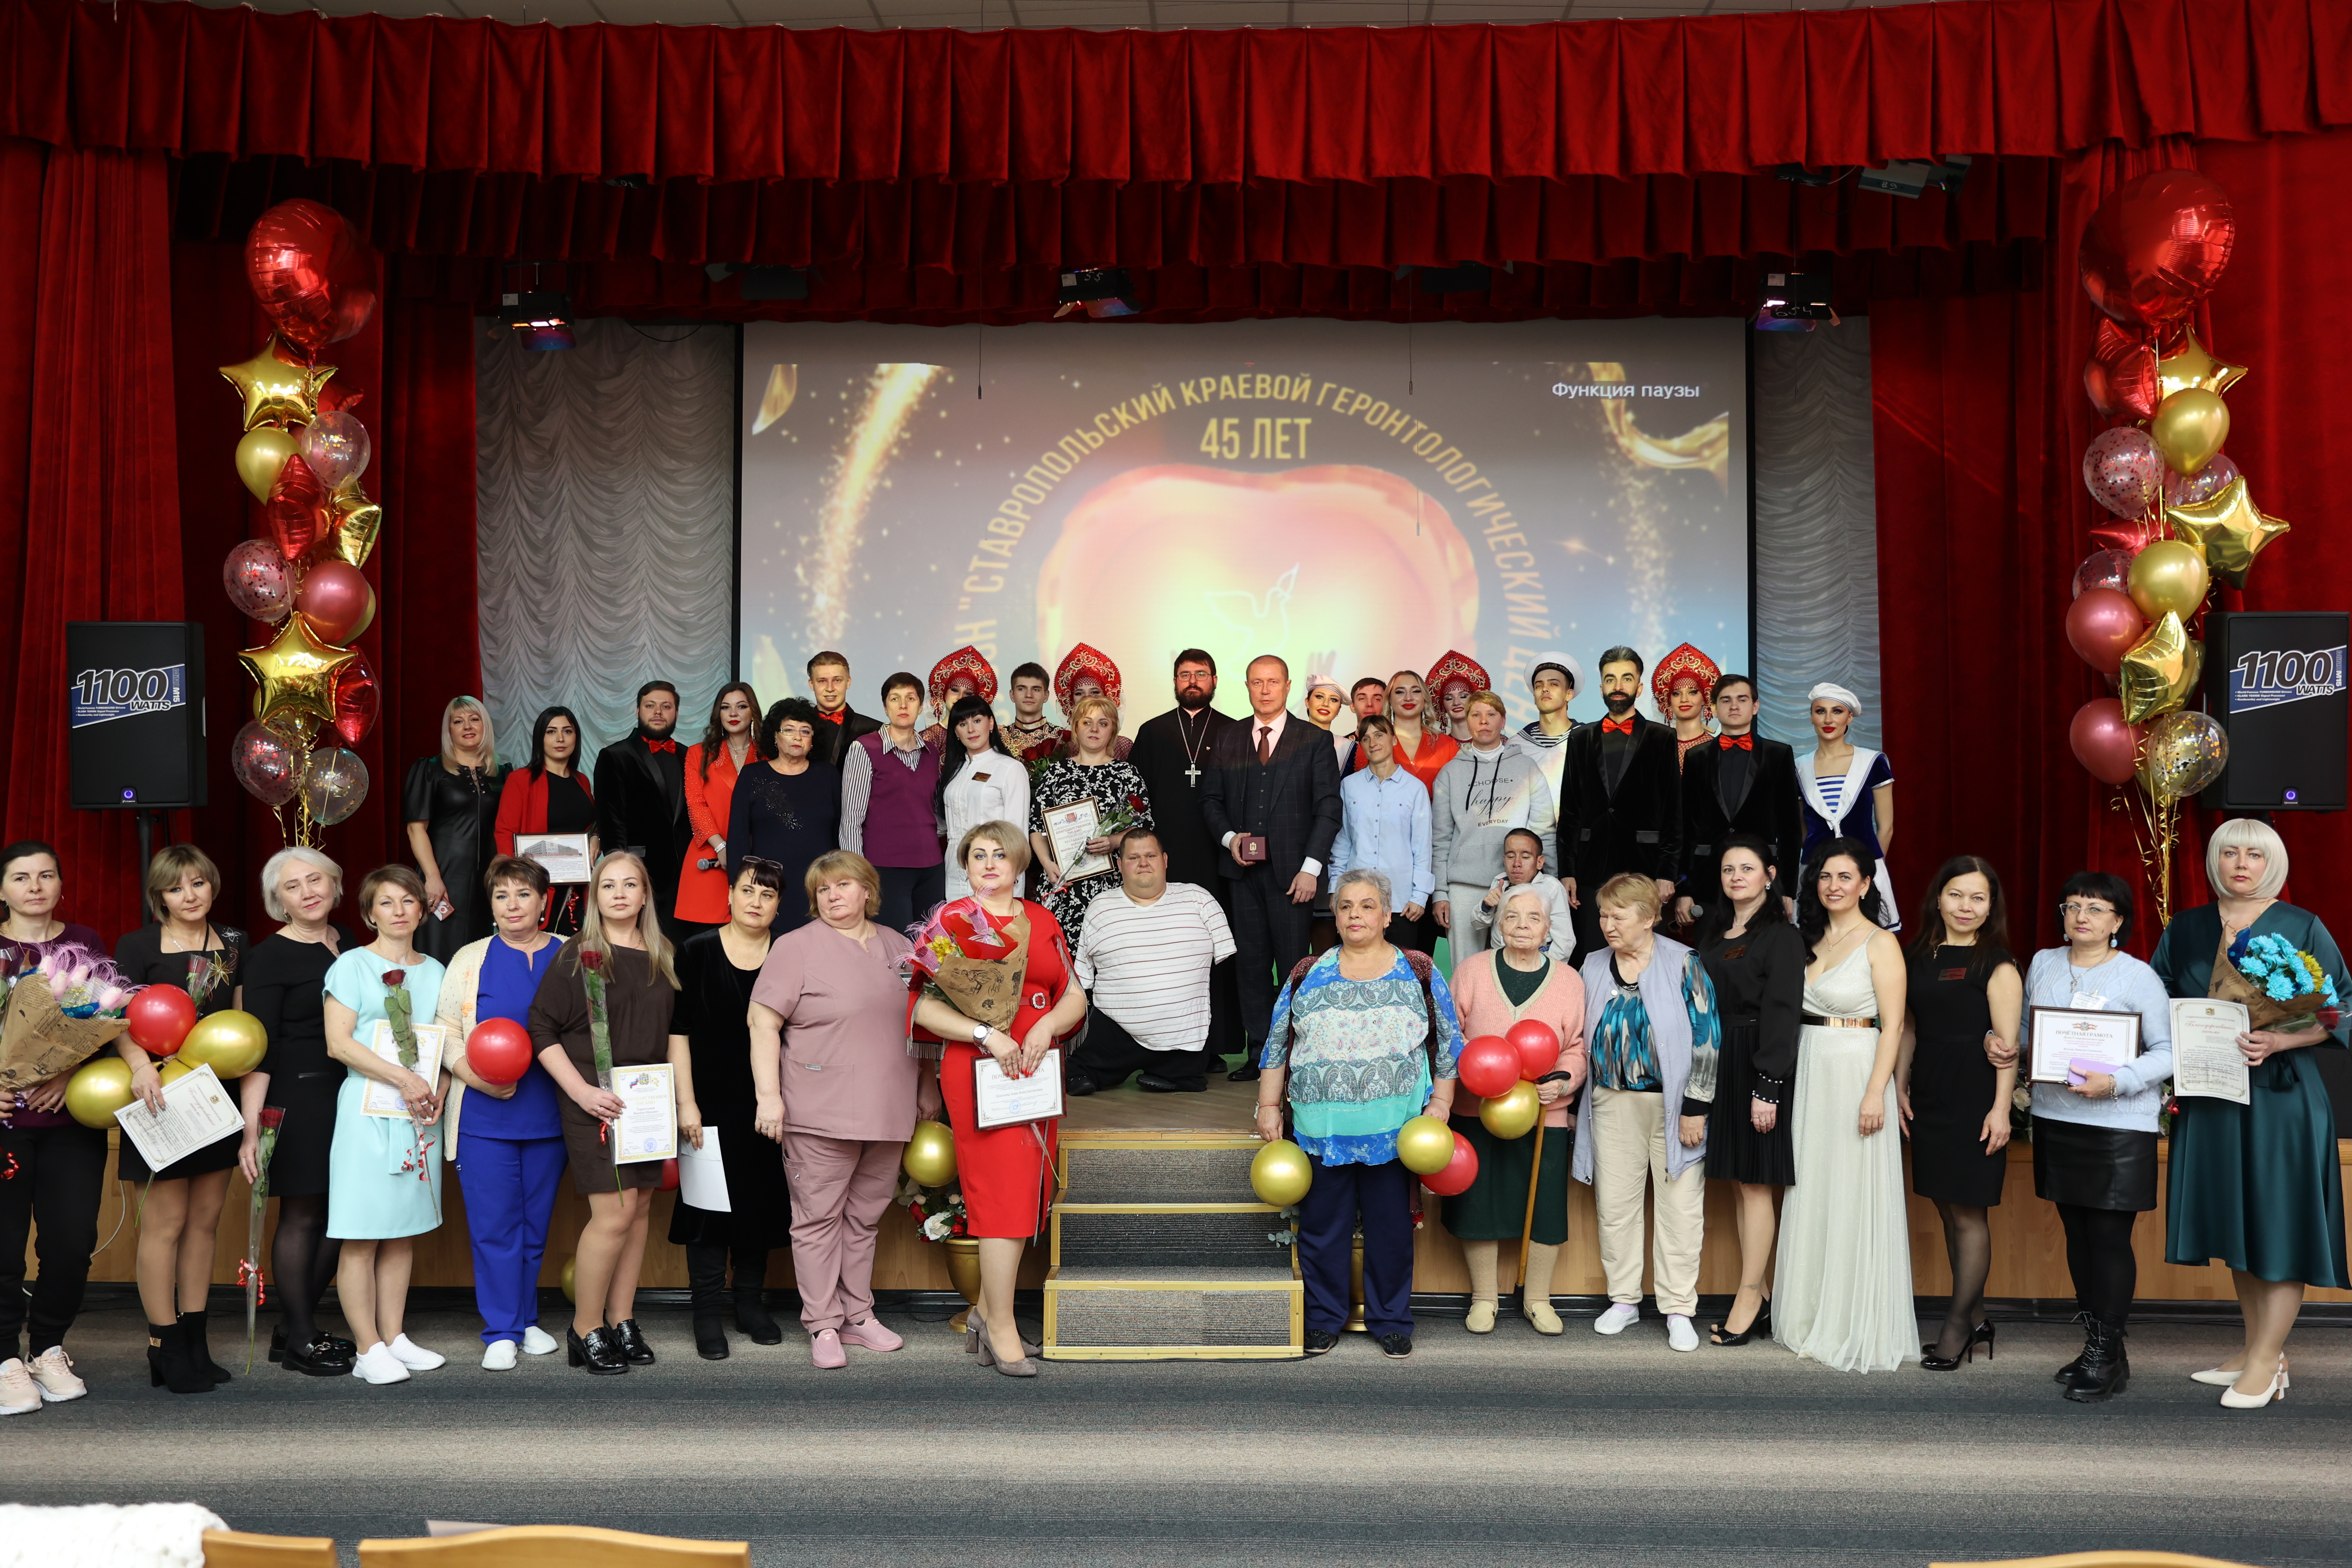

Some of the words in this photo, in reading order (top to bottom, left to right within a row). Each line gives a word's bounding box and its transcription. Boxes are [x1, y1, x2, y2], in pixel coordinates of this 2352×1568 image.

[1552, 382, 1634, 400] Функция
[1642, 384, 1700, 400] паузы
[1200, 419, 1240, 459] 45
[1251, 418, 1311, 459] ЛЕТ
[1179, 372, 1312, 406] КРАЕВОЙ
[1316, 383, 1561, 639] ГЕРОНТОЛОГИЧЕСКИЙ
[2237, 650, 2333, 689] 1100
[77, 669, 168, 705] 1100
[2296, 684, 2334, 695] WATTS
[130, 701, 171, 711] WATTS
[1473, 778, 1510, 787] CHOOSE
[1470, 789, 1513, 816] happy
[1056, 822, 1091, 834] БЛАГОДАРСТВЕННОЕ
[1478, 819, 1509, 827] EVERYDAY
